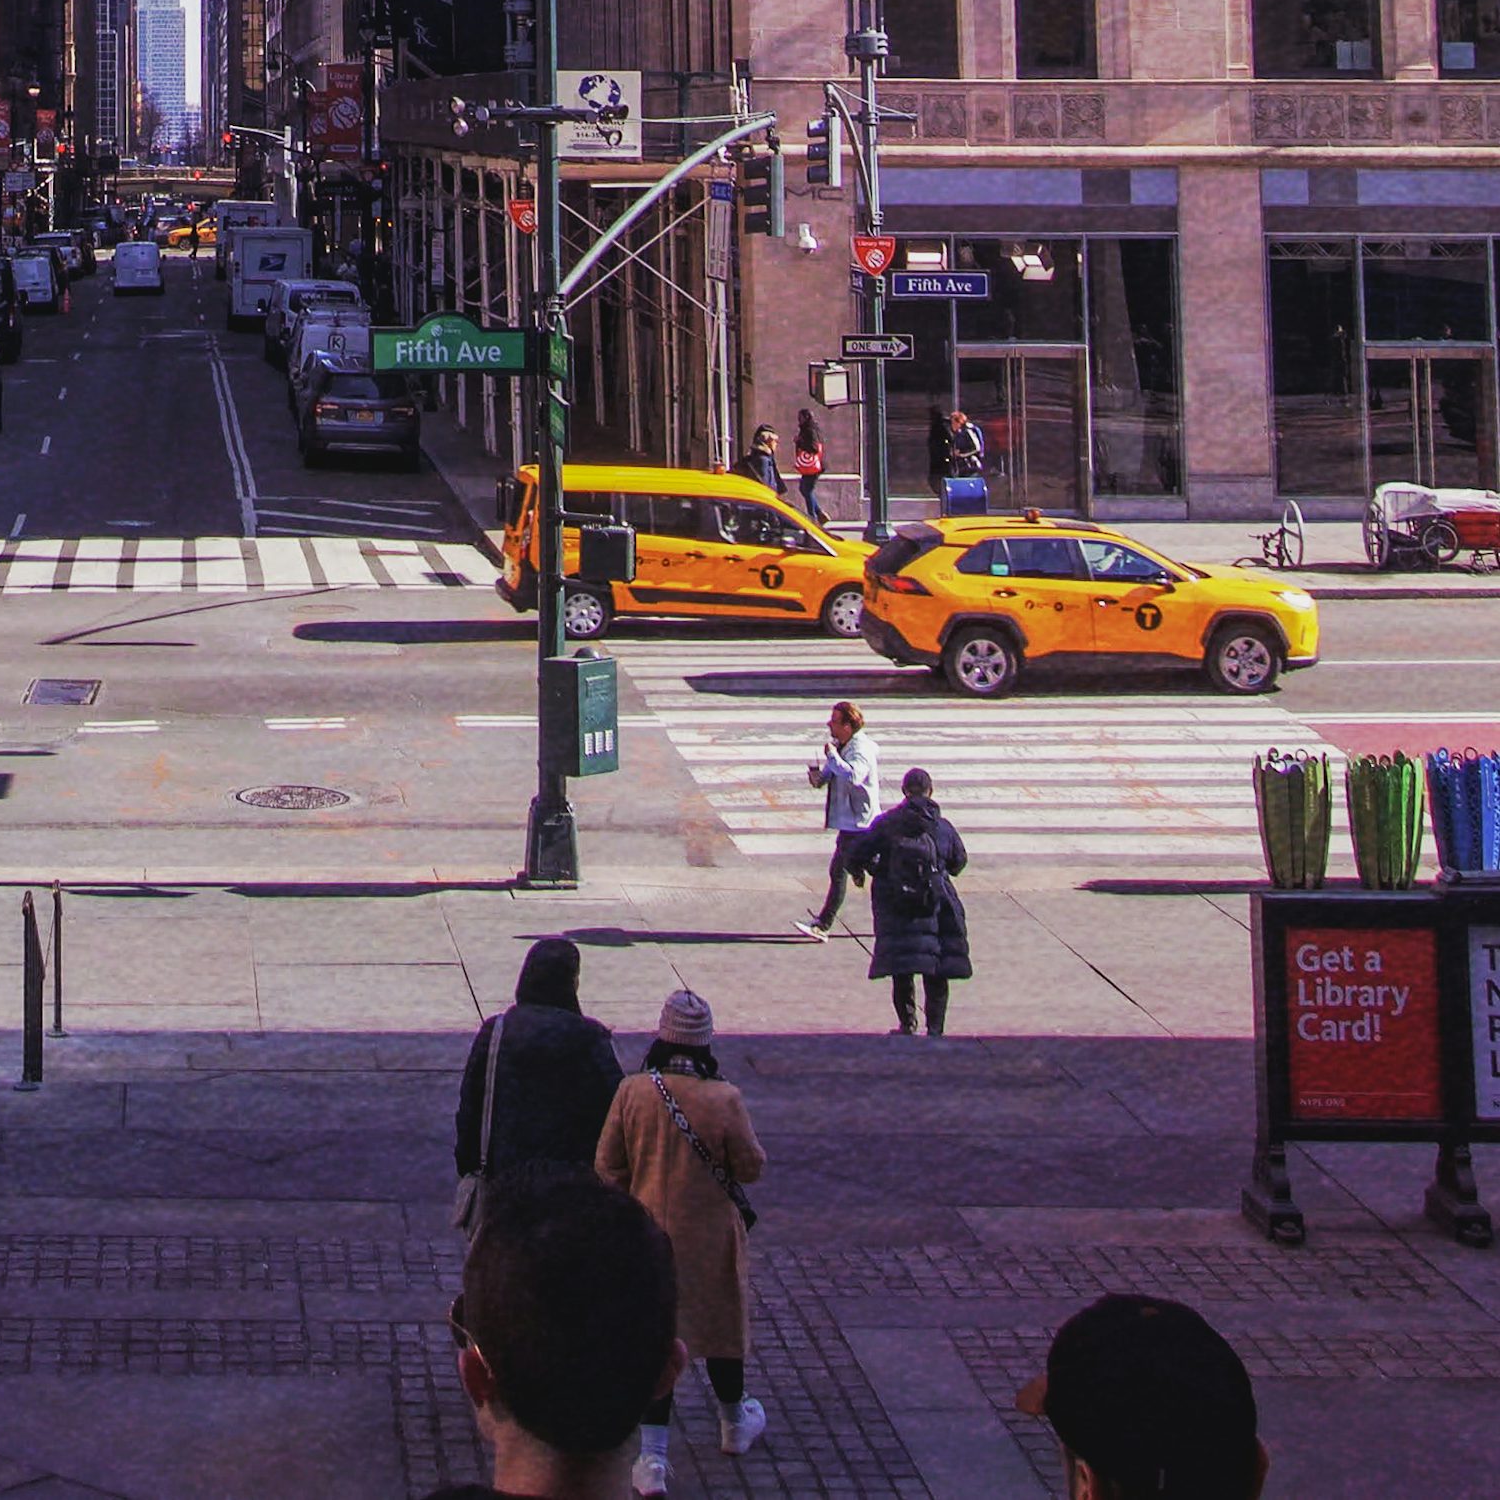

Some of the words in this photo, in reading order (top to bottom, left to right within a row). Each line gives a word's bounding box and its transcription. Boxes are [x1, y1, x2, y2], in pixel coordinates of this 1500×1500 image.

[907, 278, 942, 292] Fifth
[945, 278, 973, 292] Ave
[396, 340, 449, 363] Fifth
[456, 340, 502, 363] Ave
[851, 342, 871, 351] ONE
[881, 342, 902, 351] WAY
[1296, 944, 1354, 973] Get
[1363, 950, 1381, 973] a
[1297, 977, 1410, 1016] Library
[1297, 1012, 1382, 1042] Card!
